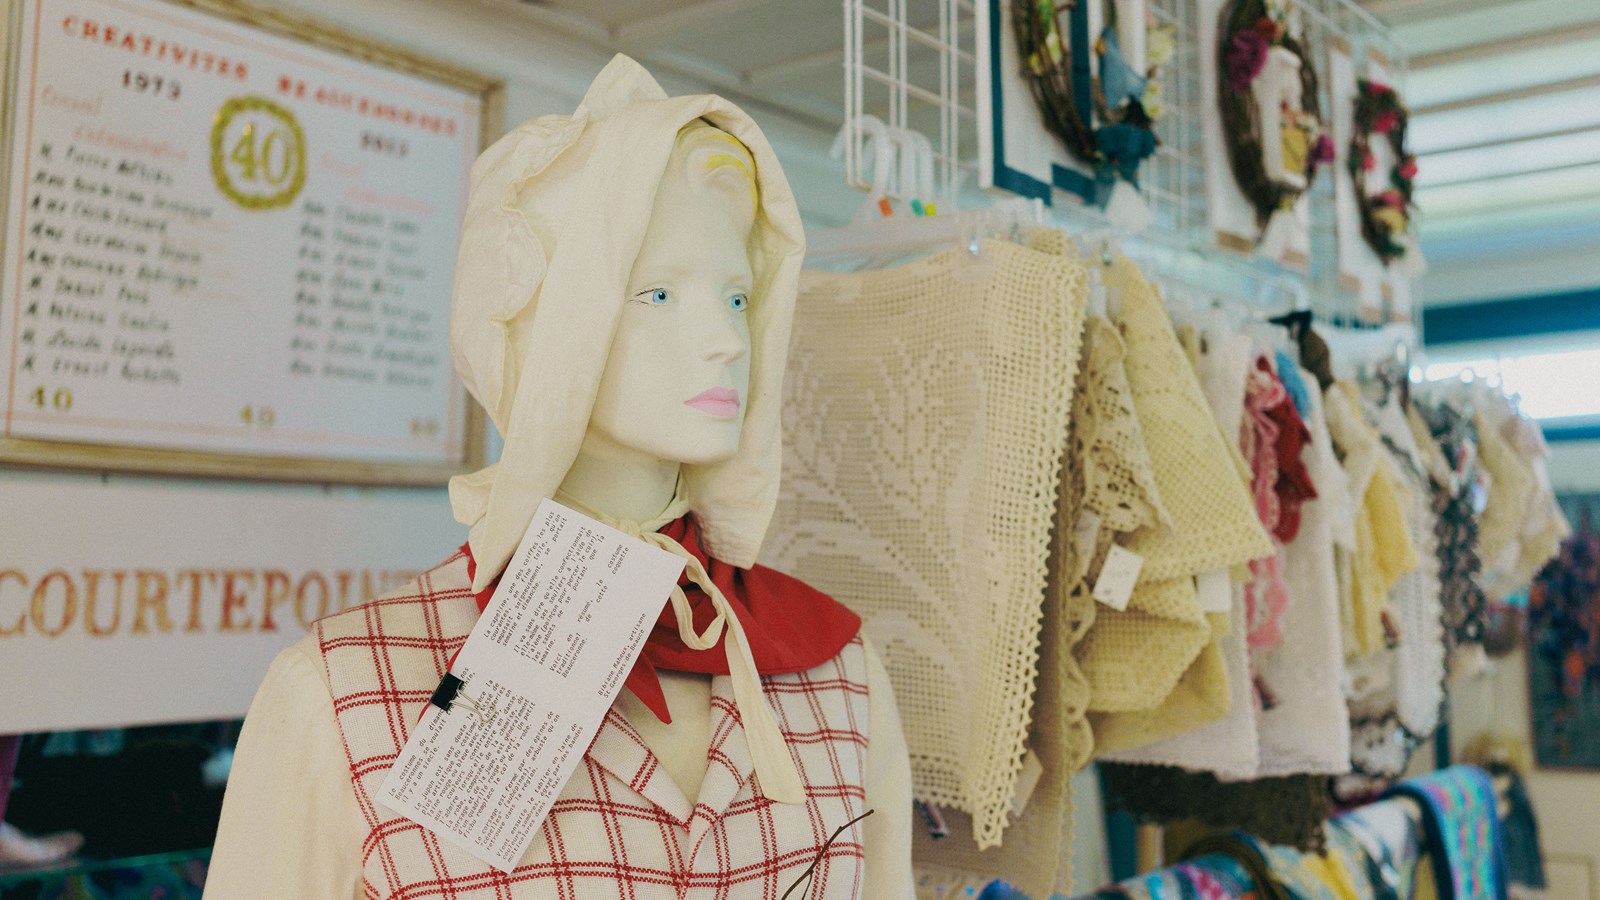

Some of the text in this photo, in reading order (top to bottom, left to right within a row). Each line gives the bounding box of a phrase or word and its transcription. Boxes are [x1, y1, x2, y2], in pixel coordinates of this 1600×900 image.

[231, 122, 292, 186] 40
[31, 385, 73, 411] 40
[483, 629, 491, 638] La
[508, 582, 516, 594] une
[515, 568, 524, 580] des
[523, 542, 539, 566] coiffes
[536, 528, 546, 539] les
[544, 511, 555, 527] plus
[496, 616, 513, 644] empesait
[552, 517, 567, 543] portait
[520, 568, 532, 583] fine
[549, 514, 561, 532] qu'on
[525, 526, 586, 633] sans dire qu'elle confectionnait
[540, 609, 549, 620] ses
[548, 576, 566, 604] souliers
[570, 541, 586, 562] l'aide
[585, 529, 593, 538] de
[557, 587, 567, 604] pour
[566, 564, 580, 587] percer
[578, 555, 586, 563] le
[502, 622, 518, 647] semaine
[531, 549, 597, 662] les sabots ne portant que
[549, 652, 563, 672] Voici
[566, 633, 574, 642] en
[595, 579, 604, 587] le
[607, 544, 623, 569] costume
[556, 547, 629, 674] traditionnel de cette coquette
[597, 670, 615, 696] Bibiane
[628, 613, 646, 641] artisane
[603, 629, 644, 698] St-Georges-de-Beauce
[388, 667, 469, 797] Le costume du nos
[395, 719, 447, 800] Beauceronnes se voulait
[414, 679, 494, 811] Le jupon est sans doute la la
[416, 771, 424, 780] un
[421, 799, 432, 816] plus
[432, 760, 455, 796] artistique
[454, 749, 461, 758] du
[492, 682, 500, 692] de
[426, 732, 479, 817] laine rouge ou bleue avec
[439, 795, 459, 824] l'admire
[458, 752, 484, 791] lorsqu'elle
[484, 730, 497, 749] entre
[496, 718, 504, 727] en
[445, 819, 454, 829] La
[485, 751, 492, 761] de
[491, 740, 499, 748] la
[517, 695, 524, 704] du
[458, 819, 469, 835] d'un
[487, 764, 500, 784] rouge
[499, 754, 506, 763] ou
[516, 721, 525, 731] Un
[523, 702, 536, 722] petit
[474, 836, 482, 845] Le
[481, 808, 498, 834] corsage
[497, 794, 506, 806] est
[517, 758, 526, 772] par
[525, 745, 534, 758] des
[547, 711, 554, 720] de
[531, 735, 548, 762] arbuste
[547, 714, 560, 733] qu'on
[434, 810, 443, 822] aux
[446, 770, 466, 800] couleurs
[452, 805, 469, 832] corsage
[473, 785, 480, 795] de
[478, 776, 486, 784] la
[496, 742, 505, 755] est
[463, 819, 477, 838] fichu
[476, 787, 495, 817] remplace
[493, 777, 501, 785] le
[500, 762, 509, 776] col
[507, 752, 515, 762] de
[512, 742, 521, 751] la
[486, 821, 506, 851] retrouve
[505, 804, 516, 820] dans
[514, 793, 522, 801] la
[496, 734, 571, 857] Vient ensuite le tablier en laine
[502, 831, 522, 860] couleurs
[552, 763, 561, 777] par
[560, 750, 570, 762] des
[568, 726, 583, 749] bandes
[507, 819, 535, 863] multicolores
[535, 802, 546, 817] dans
